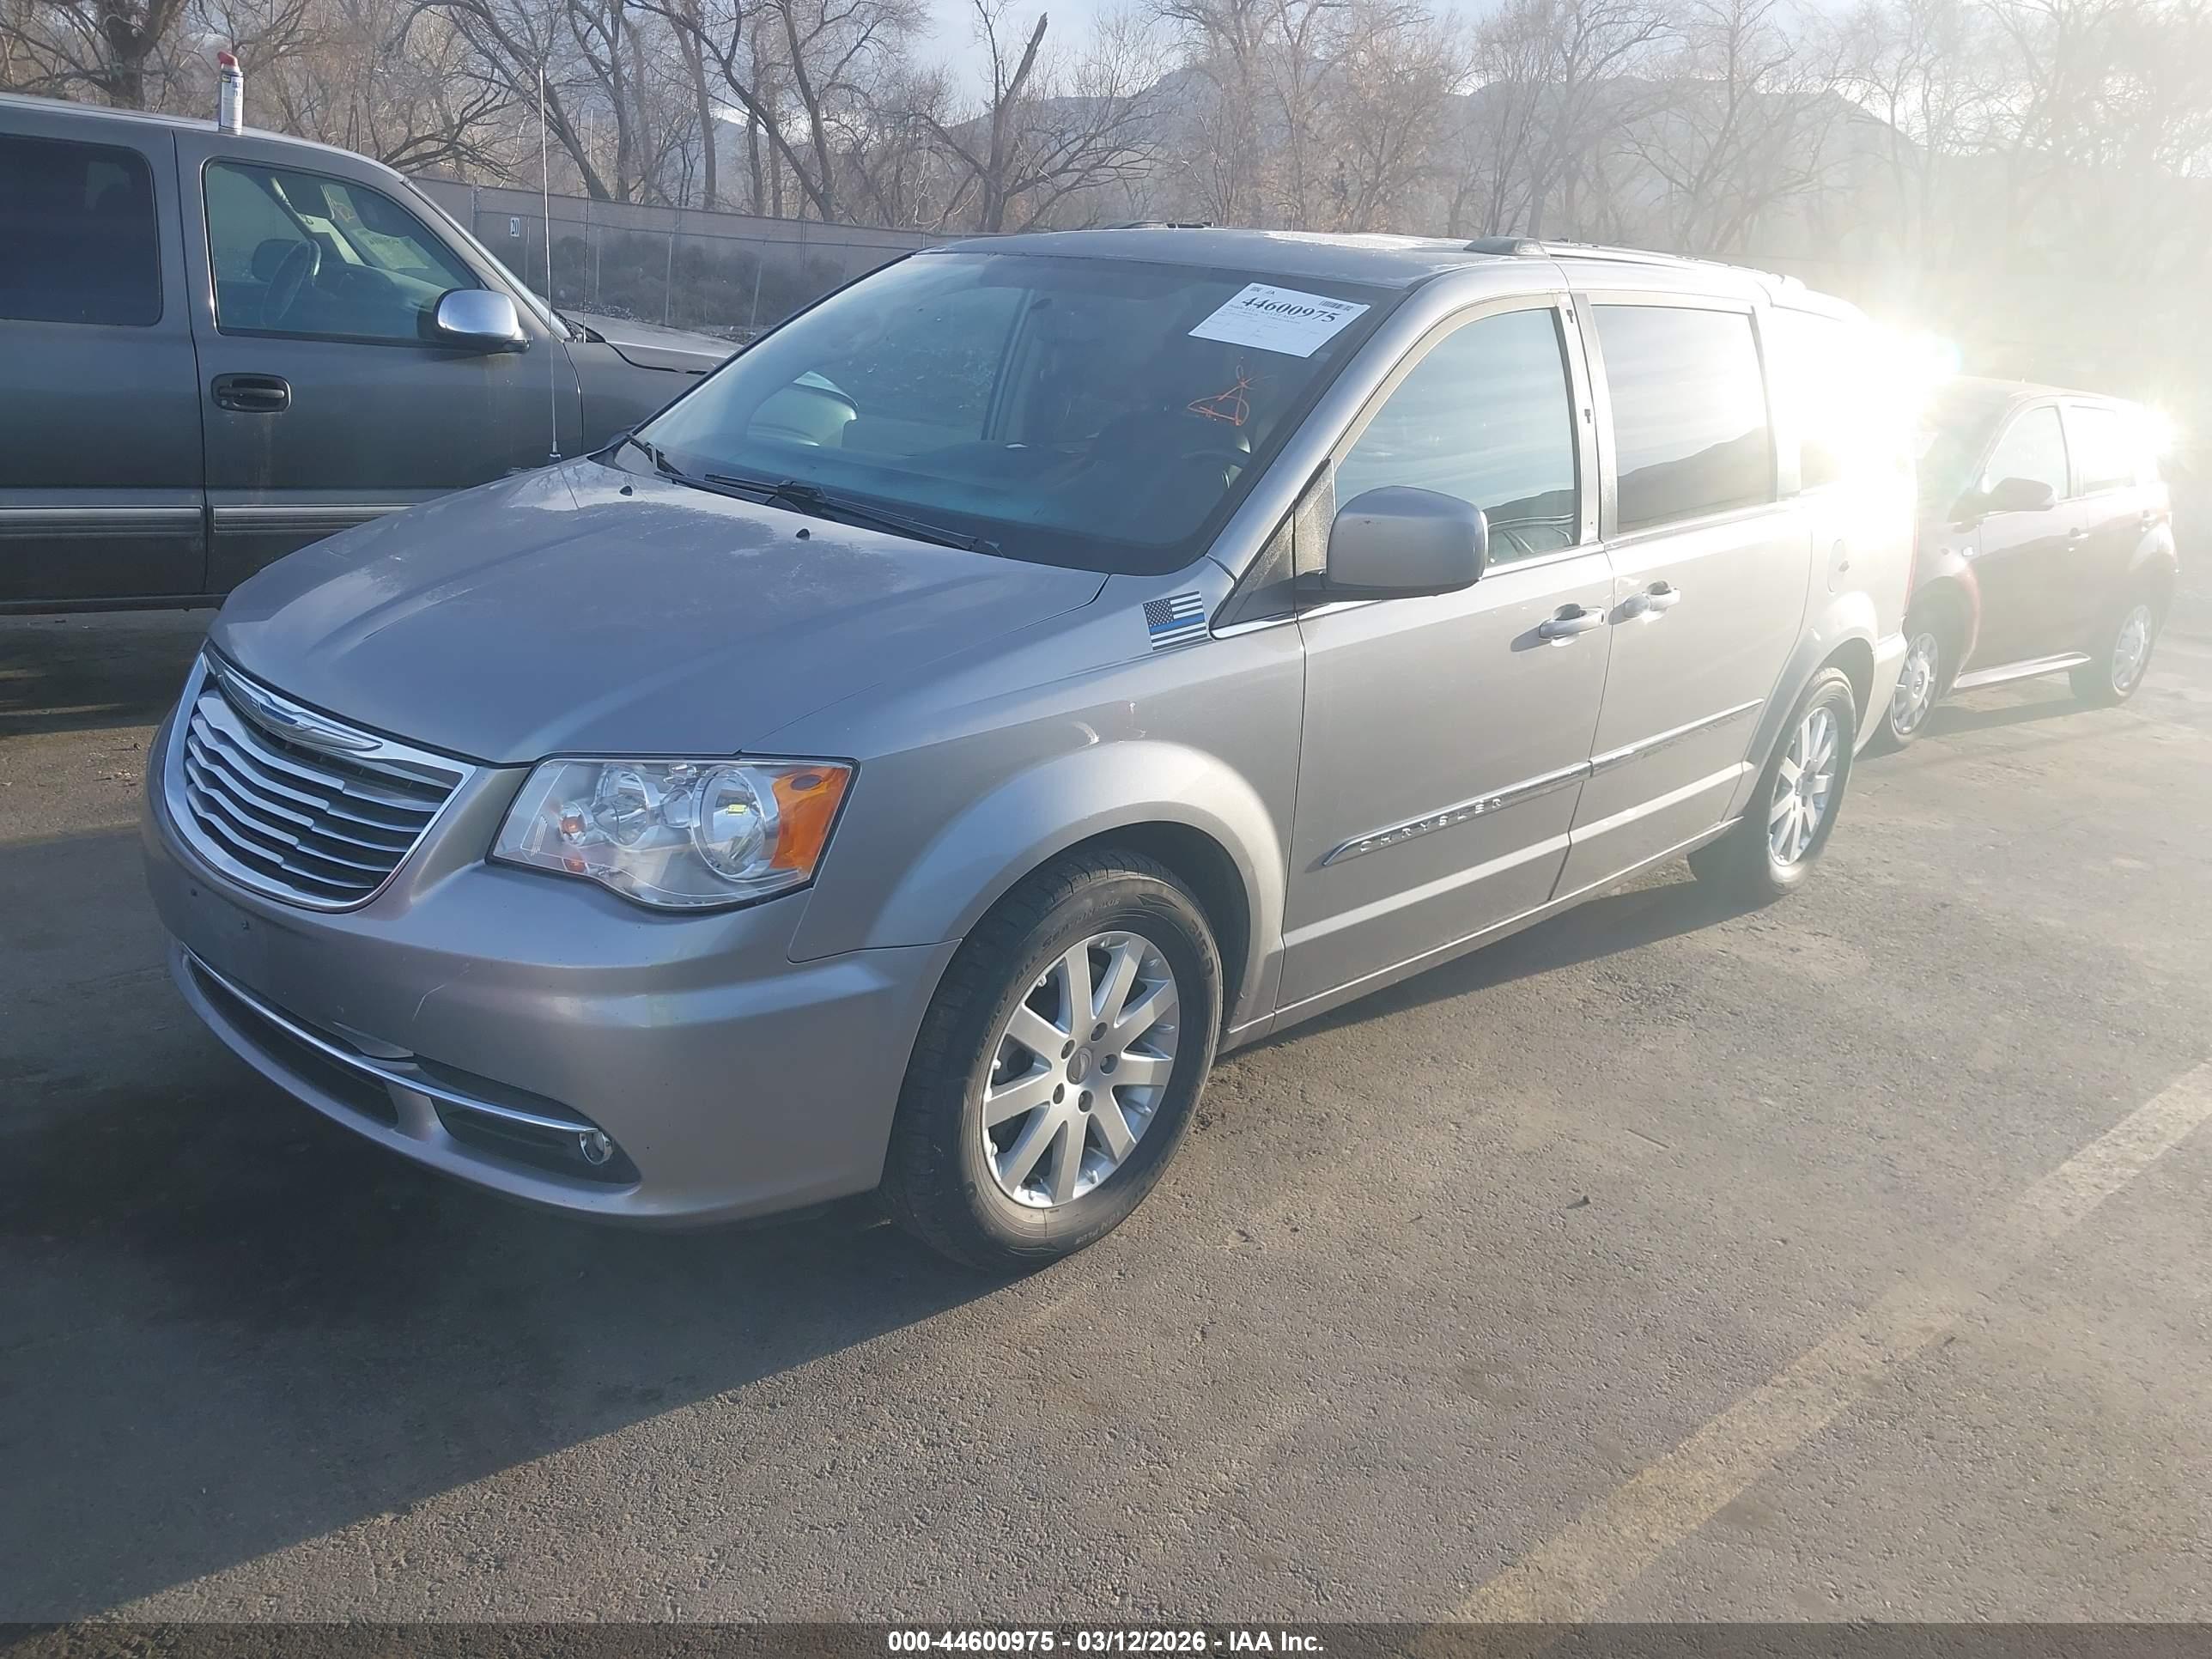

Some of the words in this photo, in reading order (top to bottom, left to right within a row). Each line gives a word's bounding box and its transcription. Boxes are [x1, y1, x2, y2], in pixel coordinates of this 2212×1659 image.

[511, 219, 520, 235] 20
[1242, 296, 1341, 323] 44600975
[1359, 798, 1502, 852] CHRYSLER
